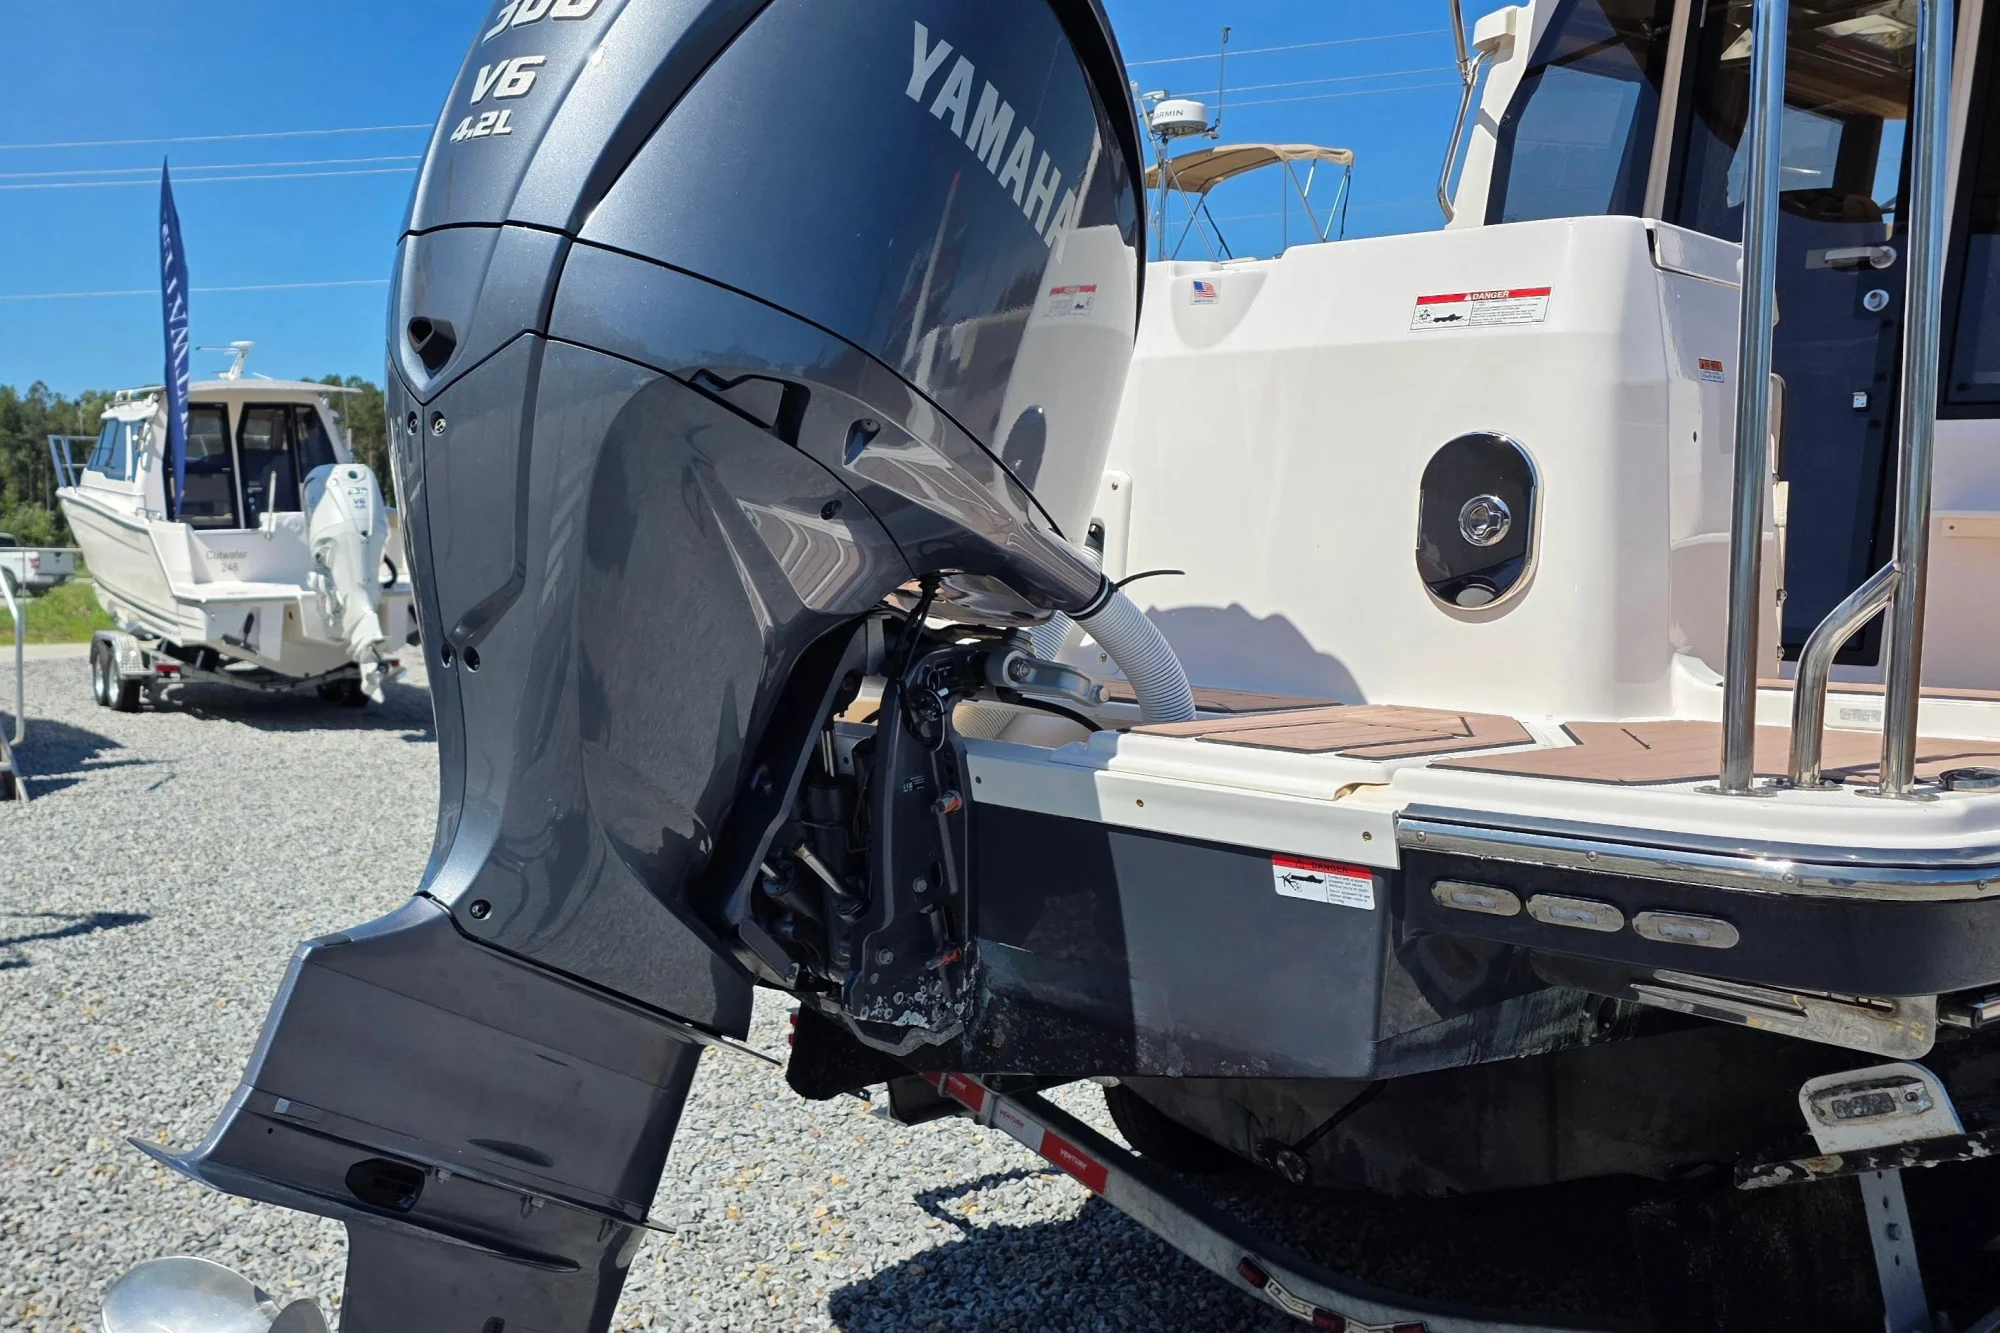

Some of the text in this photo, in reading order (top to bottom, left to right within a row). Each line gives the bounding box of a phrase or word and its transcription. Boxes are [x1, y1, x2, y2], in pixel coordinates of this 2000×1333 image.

[470, 55, 547, 106] V6
[1153, 109, 1184, 119] ARMIN
[450, 109, 513, 143] 4.2L
[905, 20, 1077, 266] YAMAHA
[1472, 290, 1510, 301] DANGER
[206, 550, 249, 559] Cutwater
[220, 562, 239, 572] 248
[1311, 861, 1349, 874] DANGER
